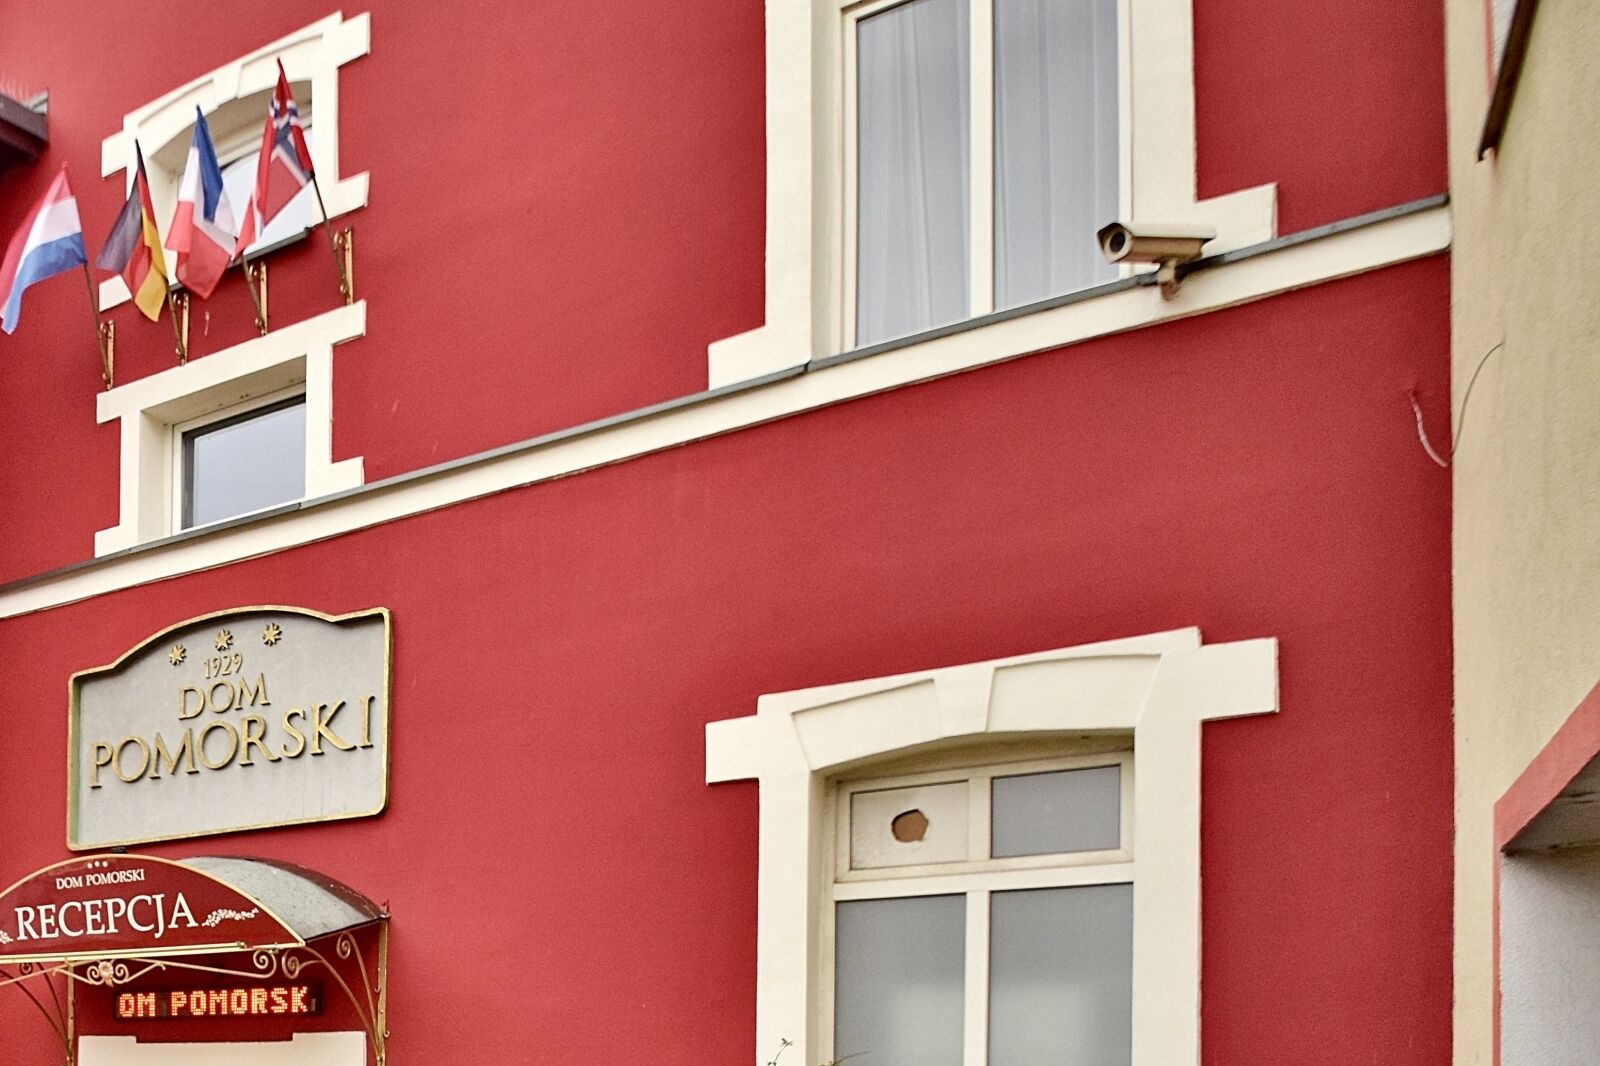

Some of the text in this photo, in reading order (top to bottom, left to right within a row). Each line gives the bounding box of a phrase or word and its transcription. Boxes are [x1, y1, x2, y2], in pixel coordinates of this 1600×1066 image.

[203, 651, 244, 679] 1929
[177, 673, 271, 720] DOM
[88, 694, 376, 789] POMORSKI
[56, 869, 145, 890] DOM POMORSKI
[14, 892, 199, 939] RECEPCJA
[119, 986, 308, 1017] OM POMORSK
